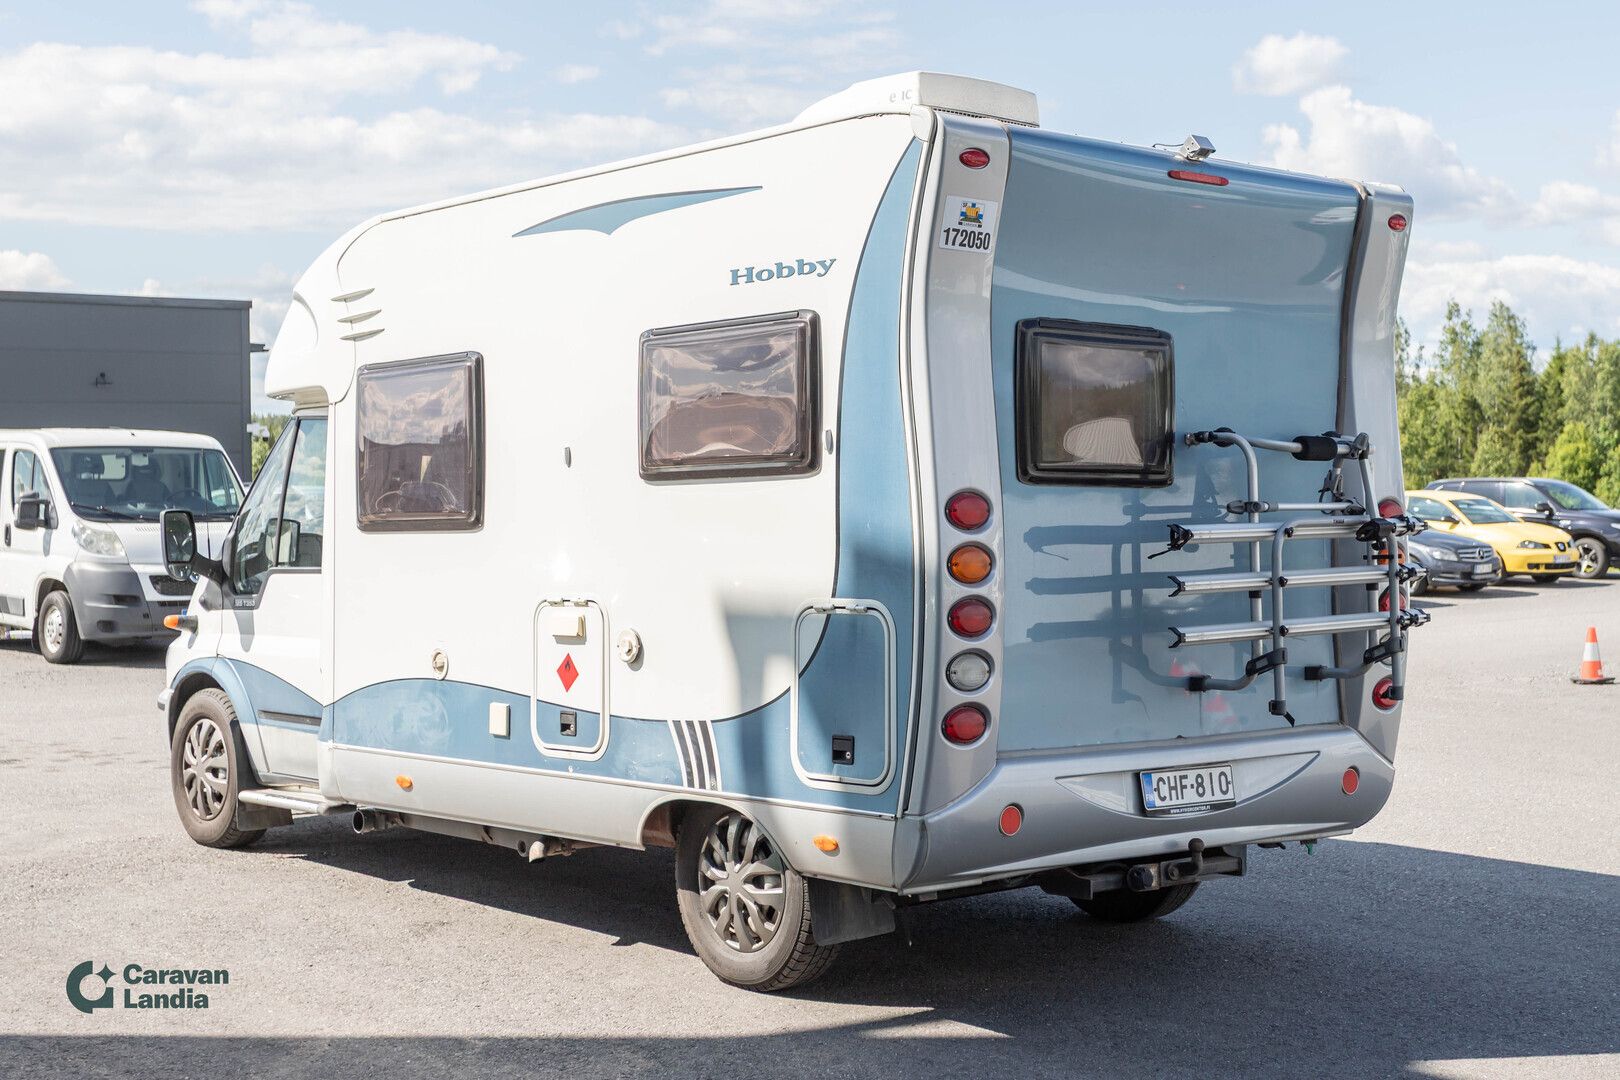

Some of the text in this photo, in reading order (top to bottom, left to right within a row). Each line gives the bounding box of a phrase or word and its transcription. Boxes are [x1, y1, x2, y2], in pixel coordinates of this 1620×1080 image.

[943, 227, 991, 250] 172050
[730, 258, 837, 286] Hobby
[1156, 771, 1230, 802] CHF-810
